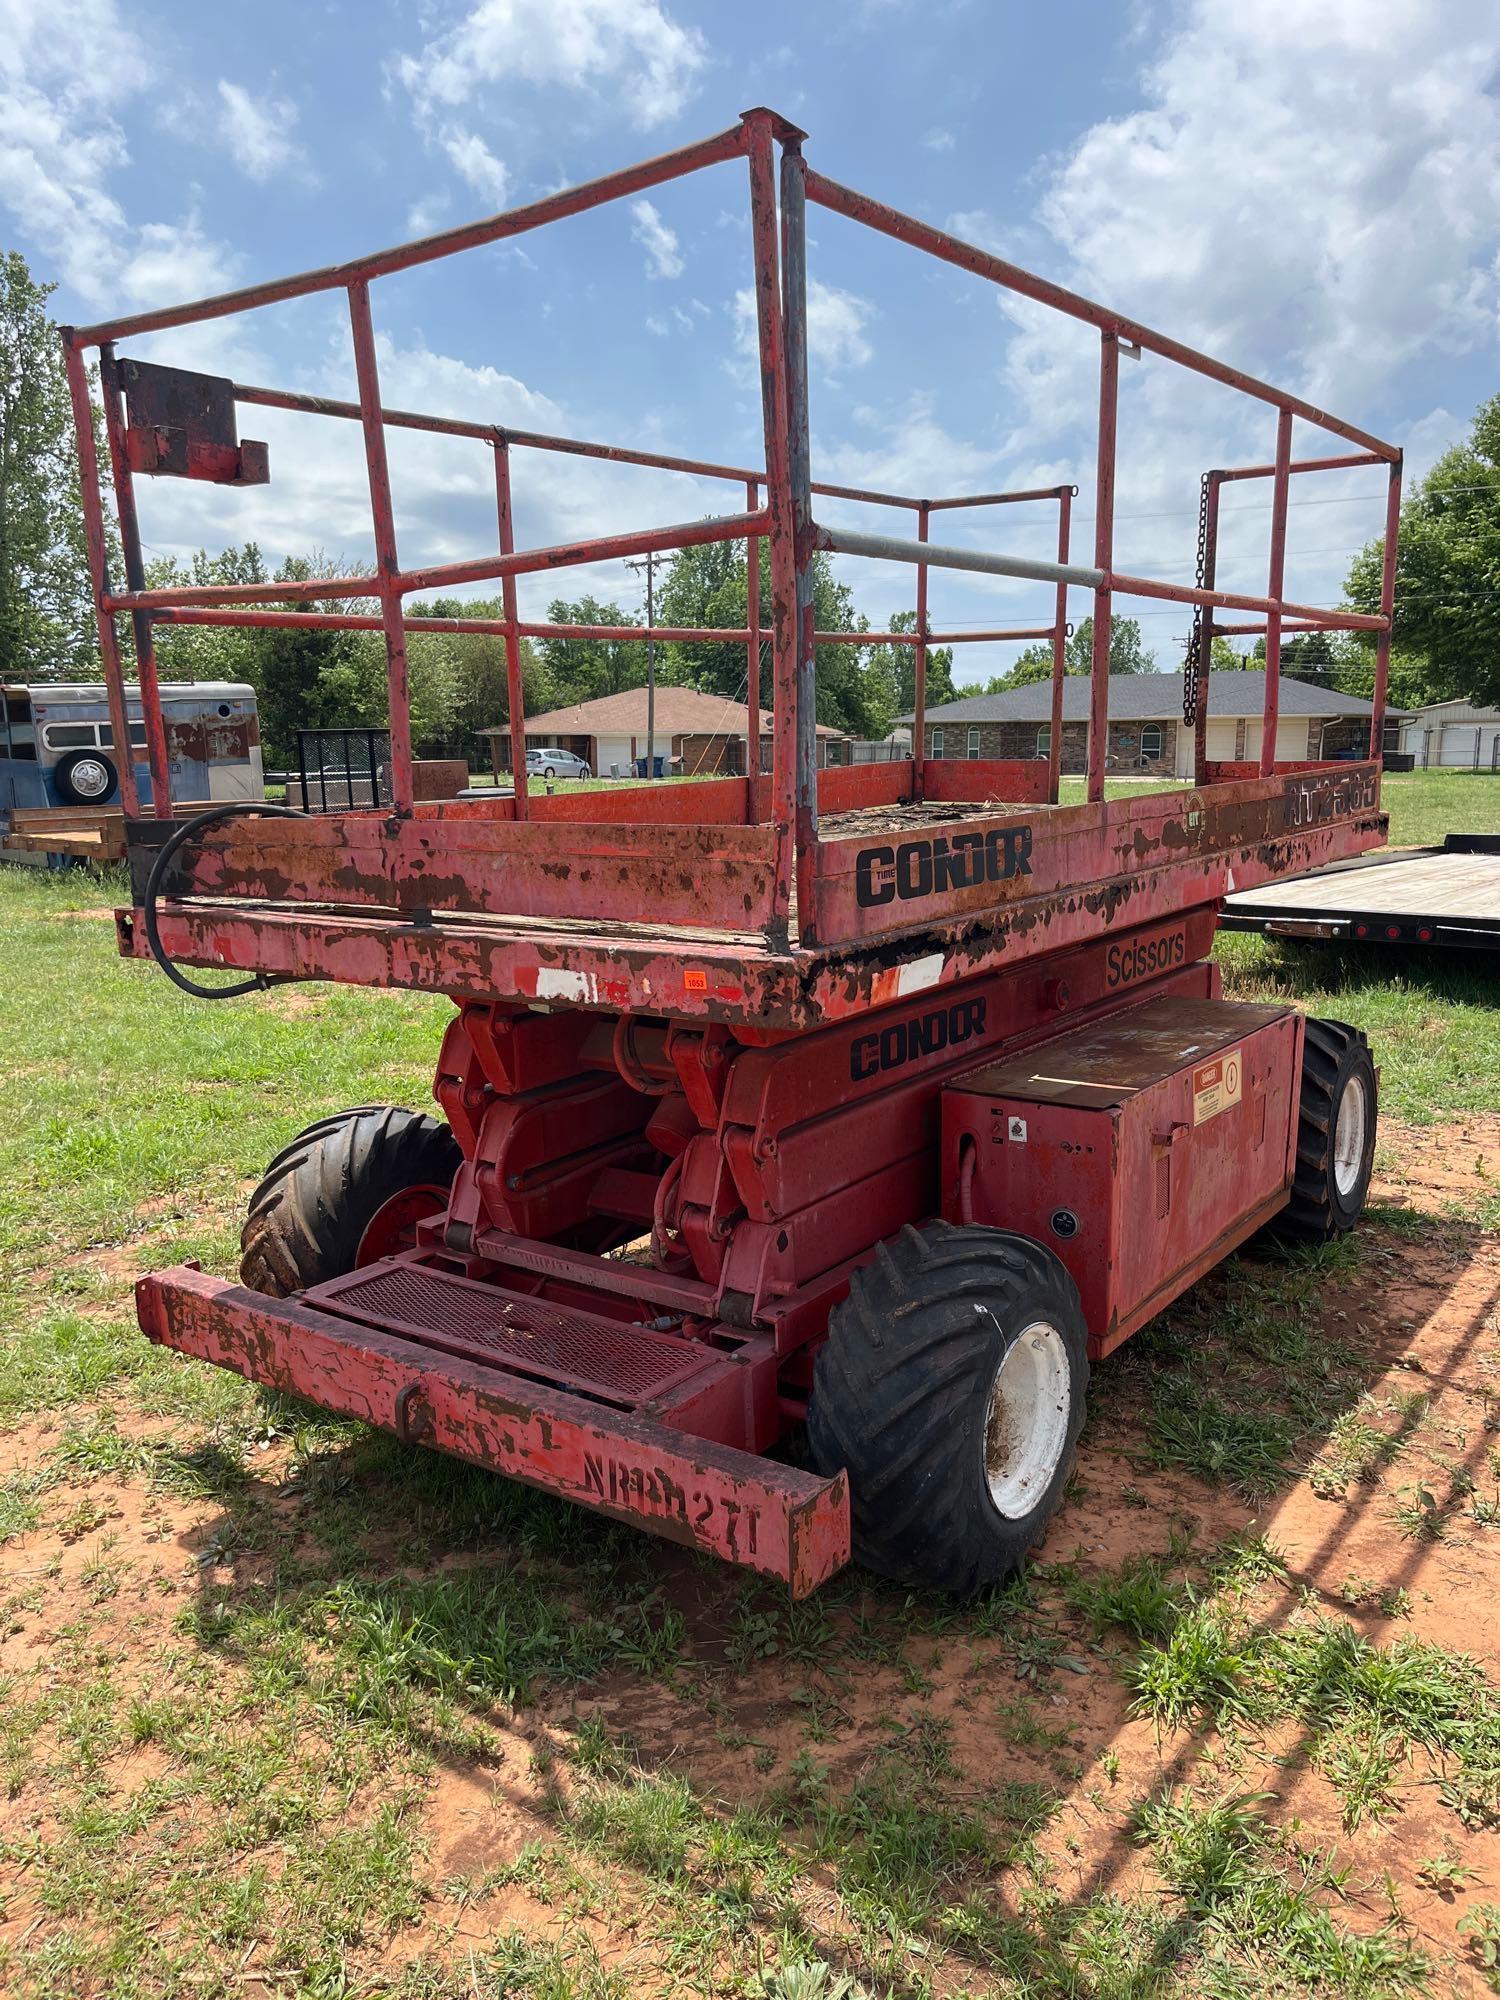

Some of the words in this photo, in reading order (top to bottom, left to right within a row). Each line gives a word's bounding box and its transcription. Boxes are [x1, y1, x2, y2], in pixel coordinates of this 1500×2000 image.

[856, 825, 1033, 908] CONDOR
[876, 869, 896, 880] TIME
[688, 979, 704, 988] 1053
[1107, 932, 1184, 987] Scissors
[850, 996, 987, 1081] CONDOR
